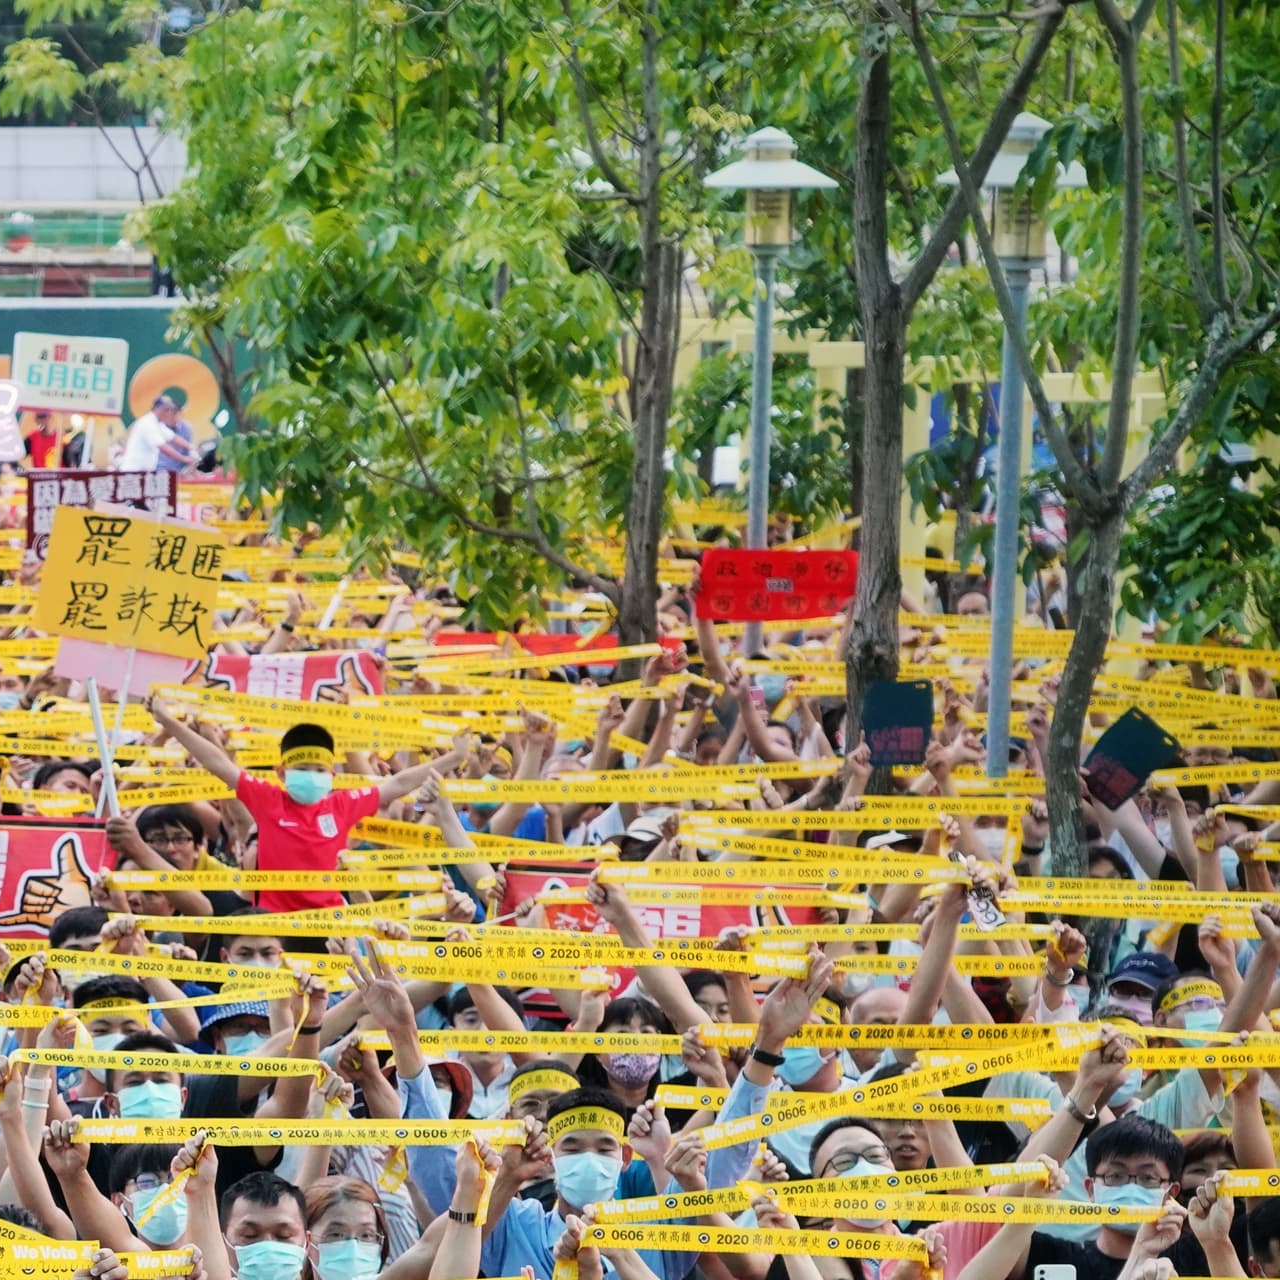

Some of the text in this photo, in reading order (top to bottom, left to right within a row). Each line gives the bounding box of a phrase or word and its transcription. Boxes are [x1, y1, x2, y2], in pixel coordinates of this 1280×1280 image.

[452, 947, 482, 958] 0606
[550, 948, 580, 959] 2020
[42, 1244, 77, 1260] Vote
